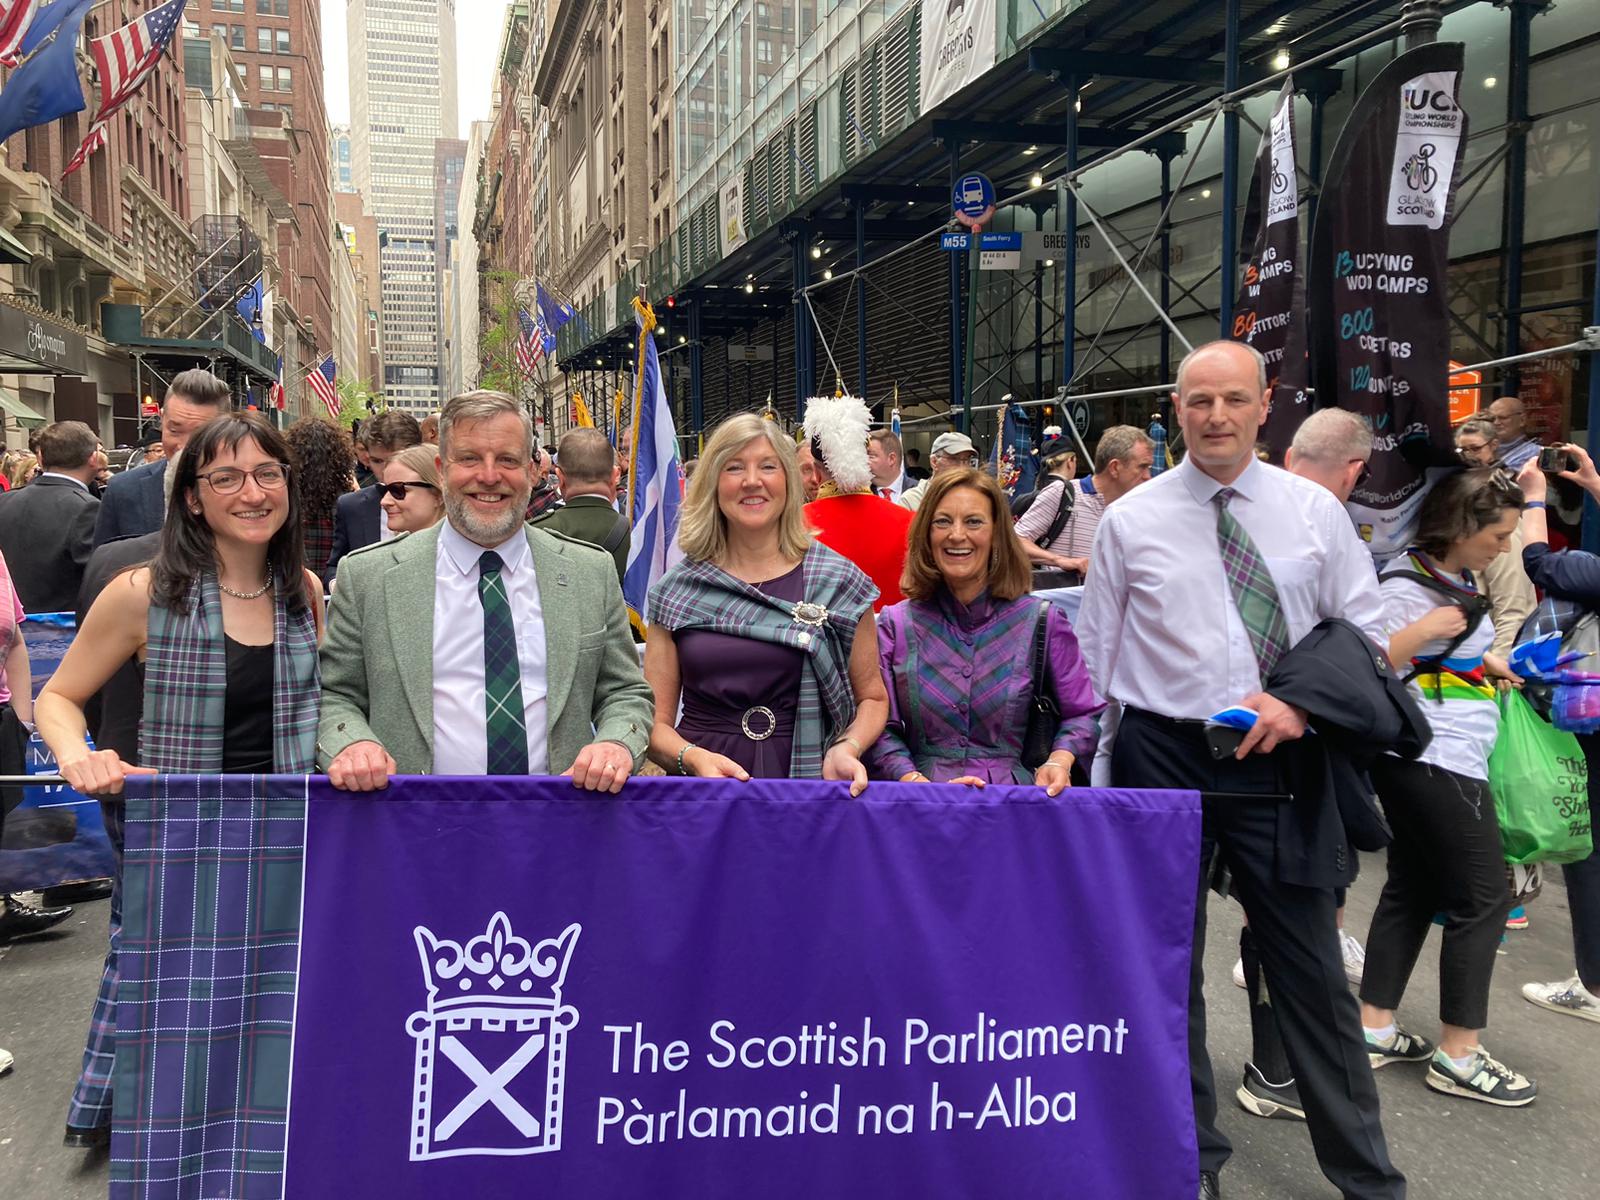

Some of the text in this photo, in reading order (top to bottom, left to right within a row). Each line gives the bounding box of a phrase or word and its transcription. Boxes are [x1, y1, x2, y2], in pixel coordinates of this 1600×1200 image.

[943, 235, 967, 248] M55
[1043, 234, 1091, 249] GREGRYS
[604, 1012, 1129, 1074] The Scottish Parliament
[596, 1075, 1076, 1145] Pàrlamaid na h-Alba
